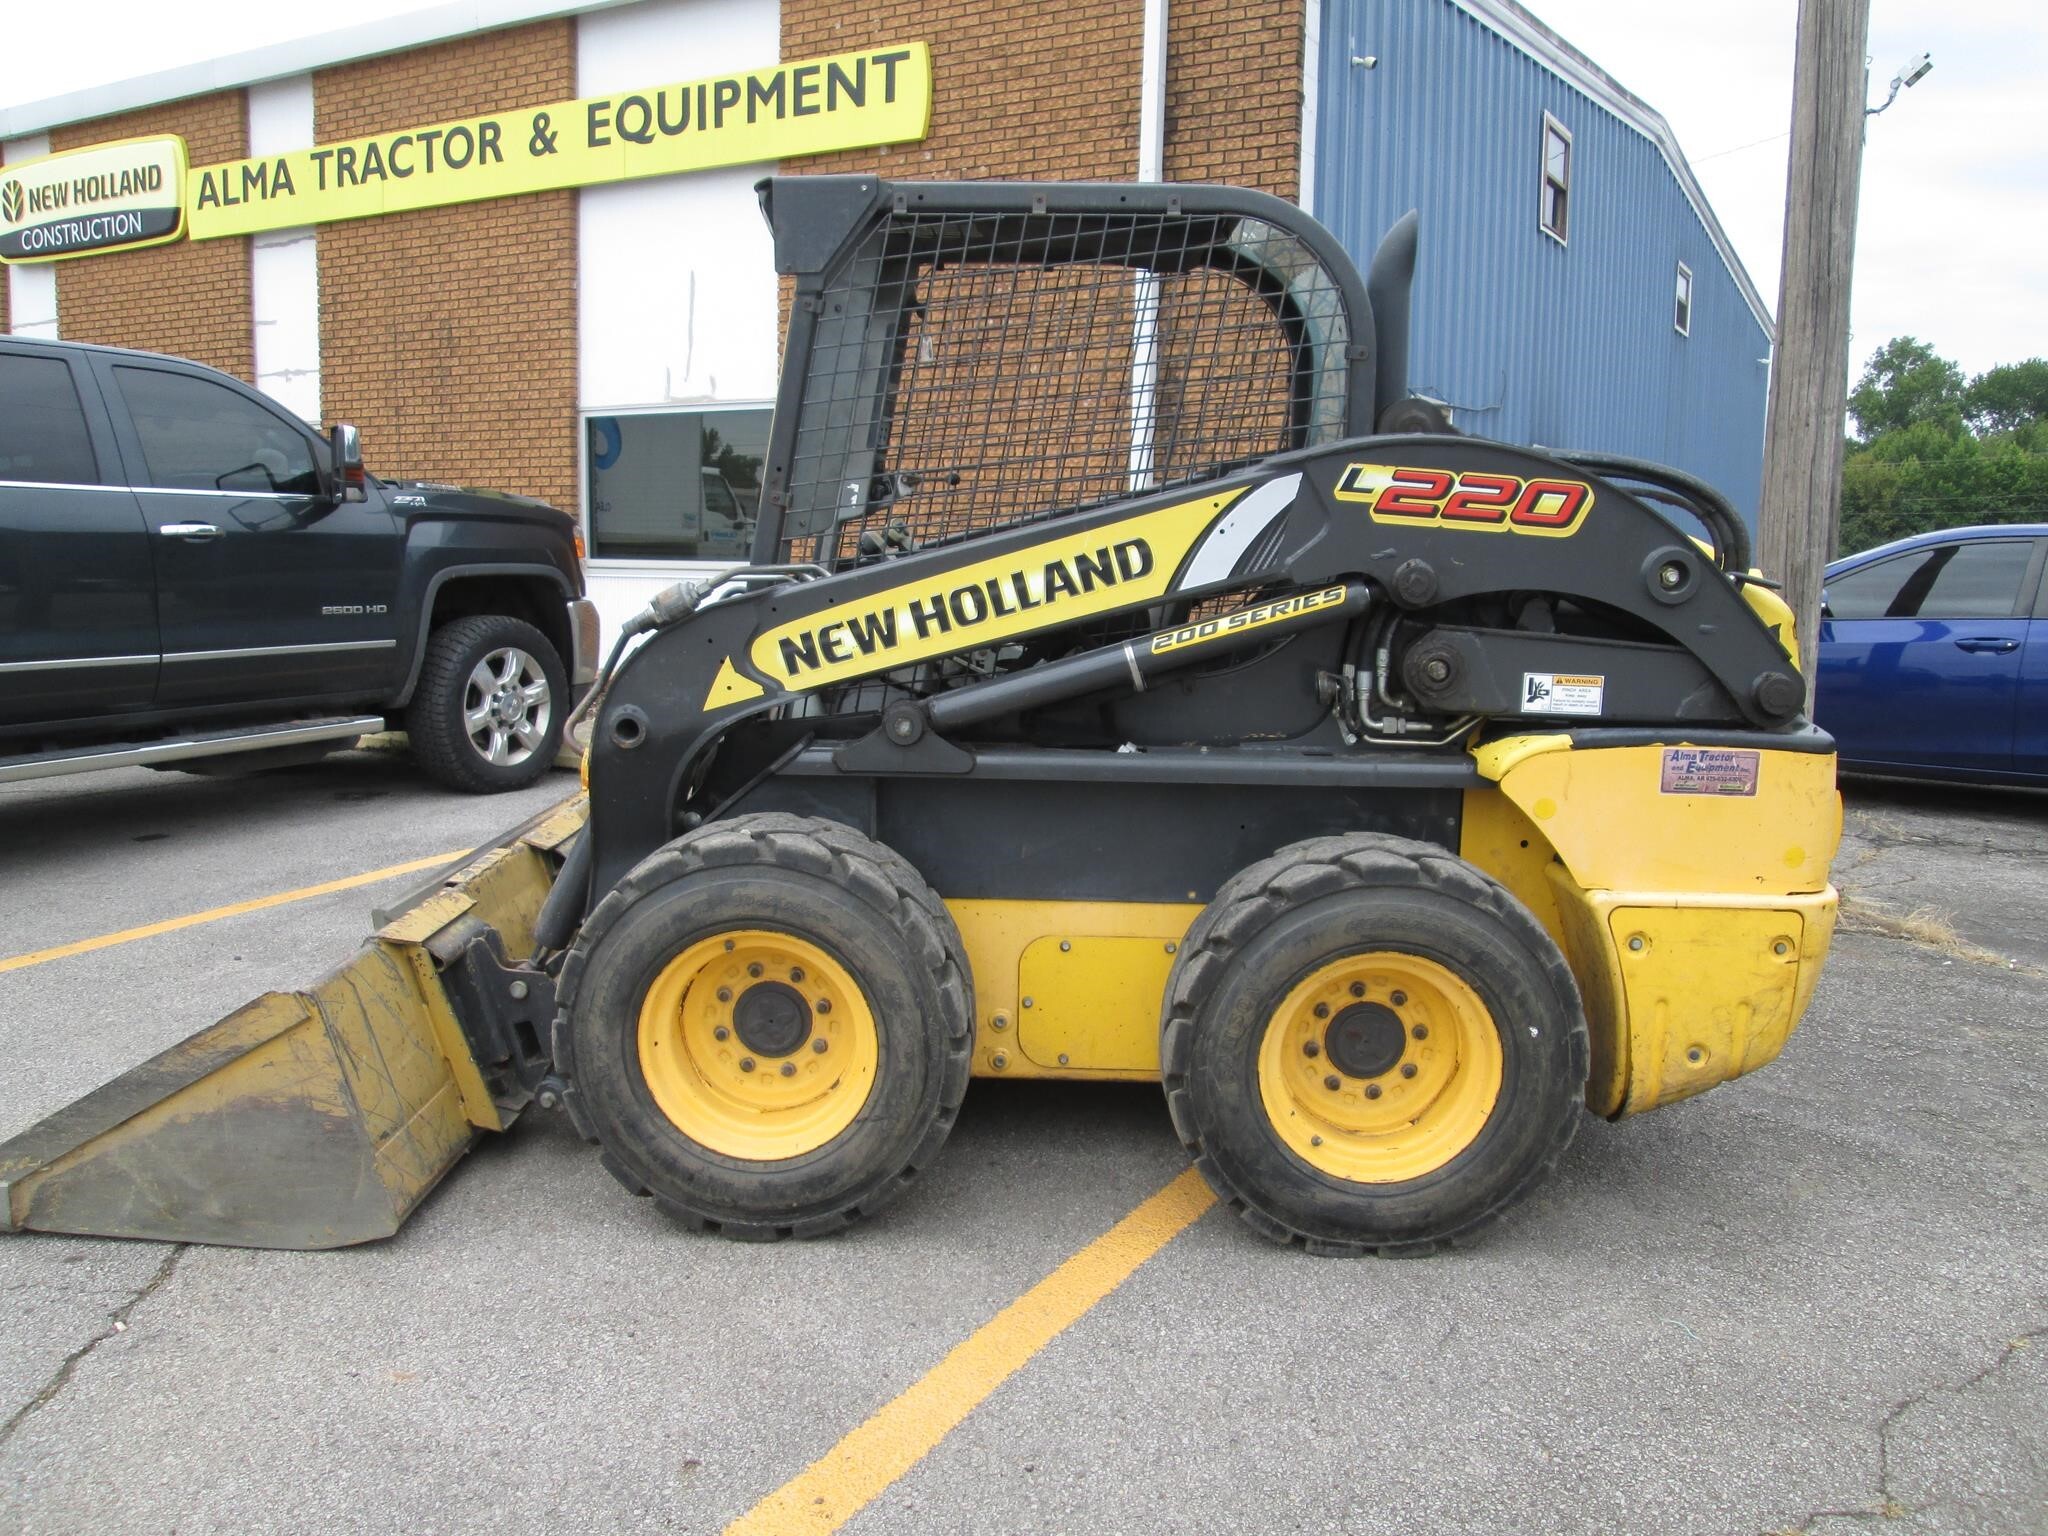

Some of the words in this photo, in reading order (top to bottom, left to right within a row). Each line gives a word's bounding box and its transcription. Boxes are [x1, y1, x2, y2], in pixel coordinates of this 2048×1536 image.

[197, 158, 296, 210] ALMA
[310, 120, 504, 191] TRACTOR
[529, 111, 558, 157] &
[587, 50, 910, 148] EQUIPMENT
[29, 181, 68, 213] NEW
[73, 164, 162, 204] HOLLAND
[21, 211, 142, 250] CONSTRUCTION
[366, 604, 387, 614] HD
[778, 607, 899, 677] NEW
[909, 536, 1155, 639] HOLLAND
[1154, 622, 1218, 650] 200
[1228, 586, 1345, 630] SERIES
[1670, 749, 1696, 761] Alma
[1698, 750, 1735, 762] Tractor
[1686, 761, 1739, 774] Equipment
